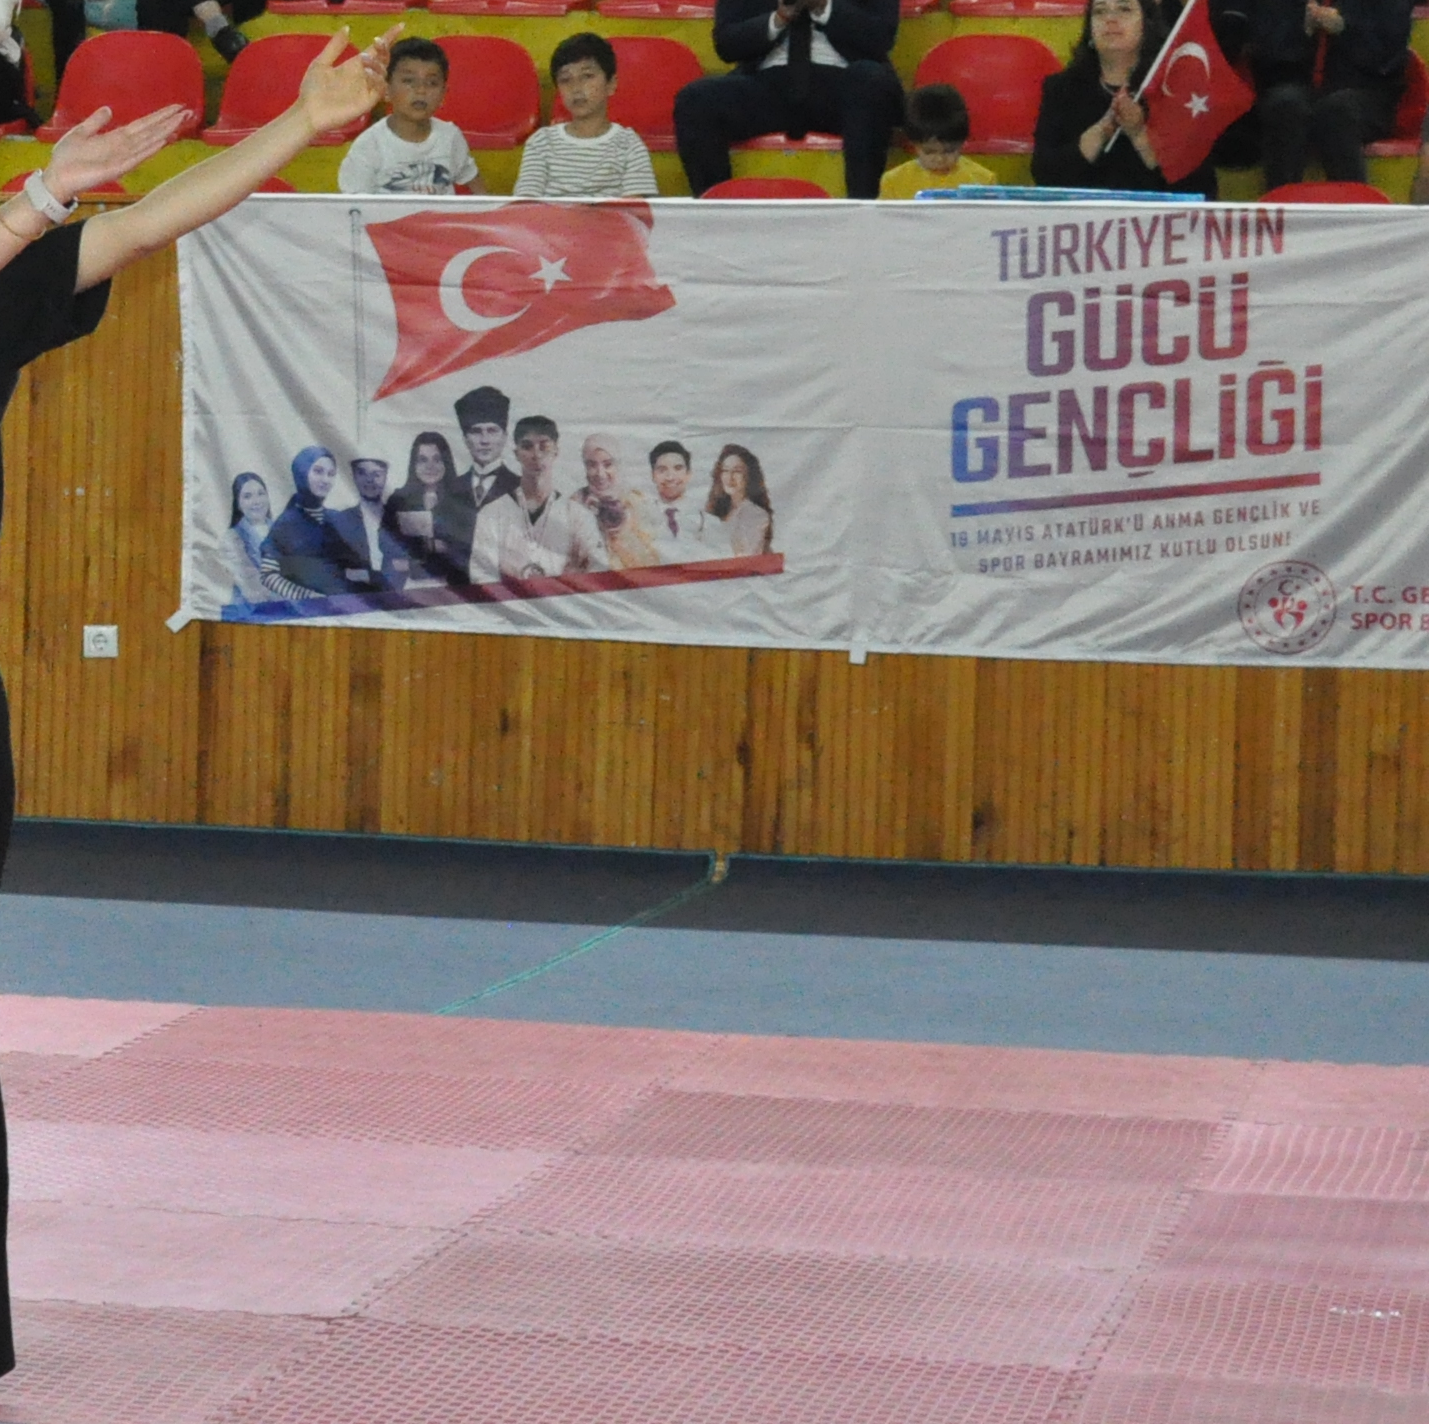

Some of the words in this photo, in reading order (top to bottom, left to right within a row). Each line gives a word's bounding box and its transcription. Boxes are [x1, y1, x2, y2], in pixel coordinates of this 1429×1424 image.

[991, 207, 1286, 282] TÜRKİYE'NİN
[1026, 271, 1250, 377] GÜCÜ
[950, 360, 1323, 484] GENÇLİĞİ
[977, 526, 1035, 547] MAYIS
[1041, 510, 1145, 540] ATATÜRK'Ü
[1152, 505, 1205, 531] ANMA
[1212, 500, 1291, 528] GENÇLİK
[1298, 499, 1321, 517] VE
[979, 553, 1026, 574] SPOR
[1035, 542, 1152, 569] BAYRAMIMIZ
[1160, 537, 1218, 559] KUTLU
[1225, 531, 1292, 553] OLSUN!
[1351, 585, 1394, 604] T.C.
[1351, 611, 1413, 631] SPOR
